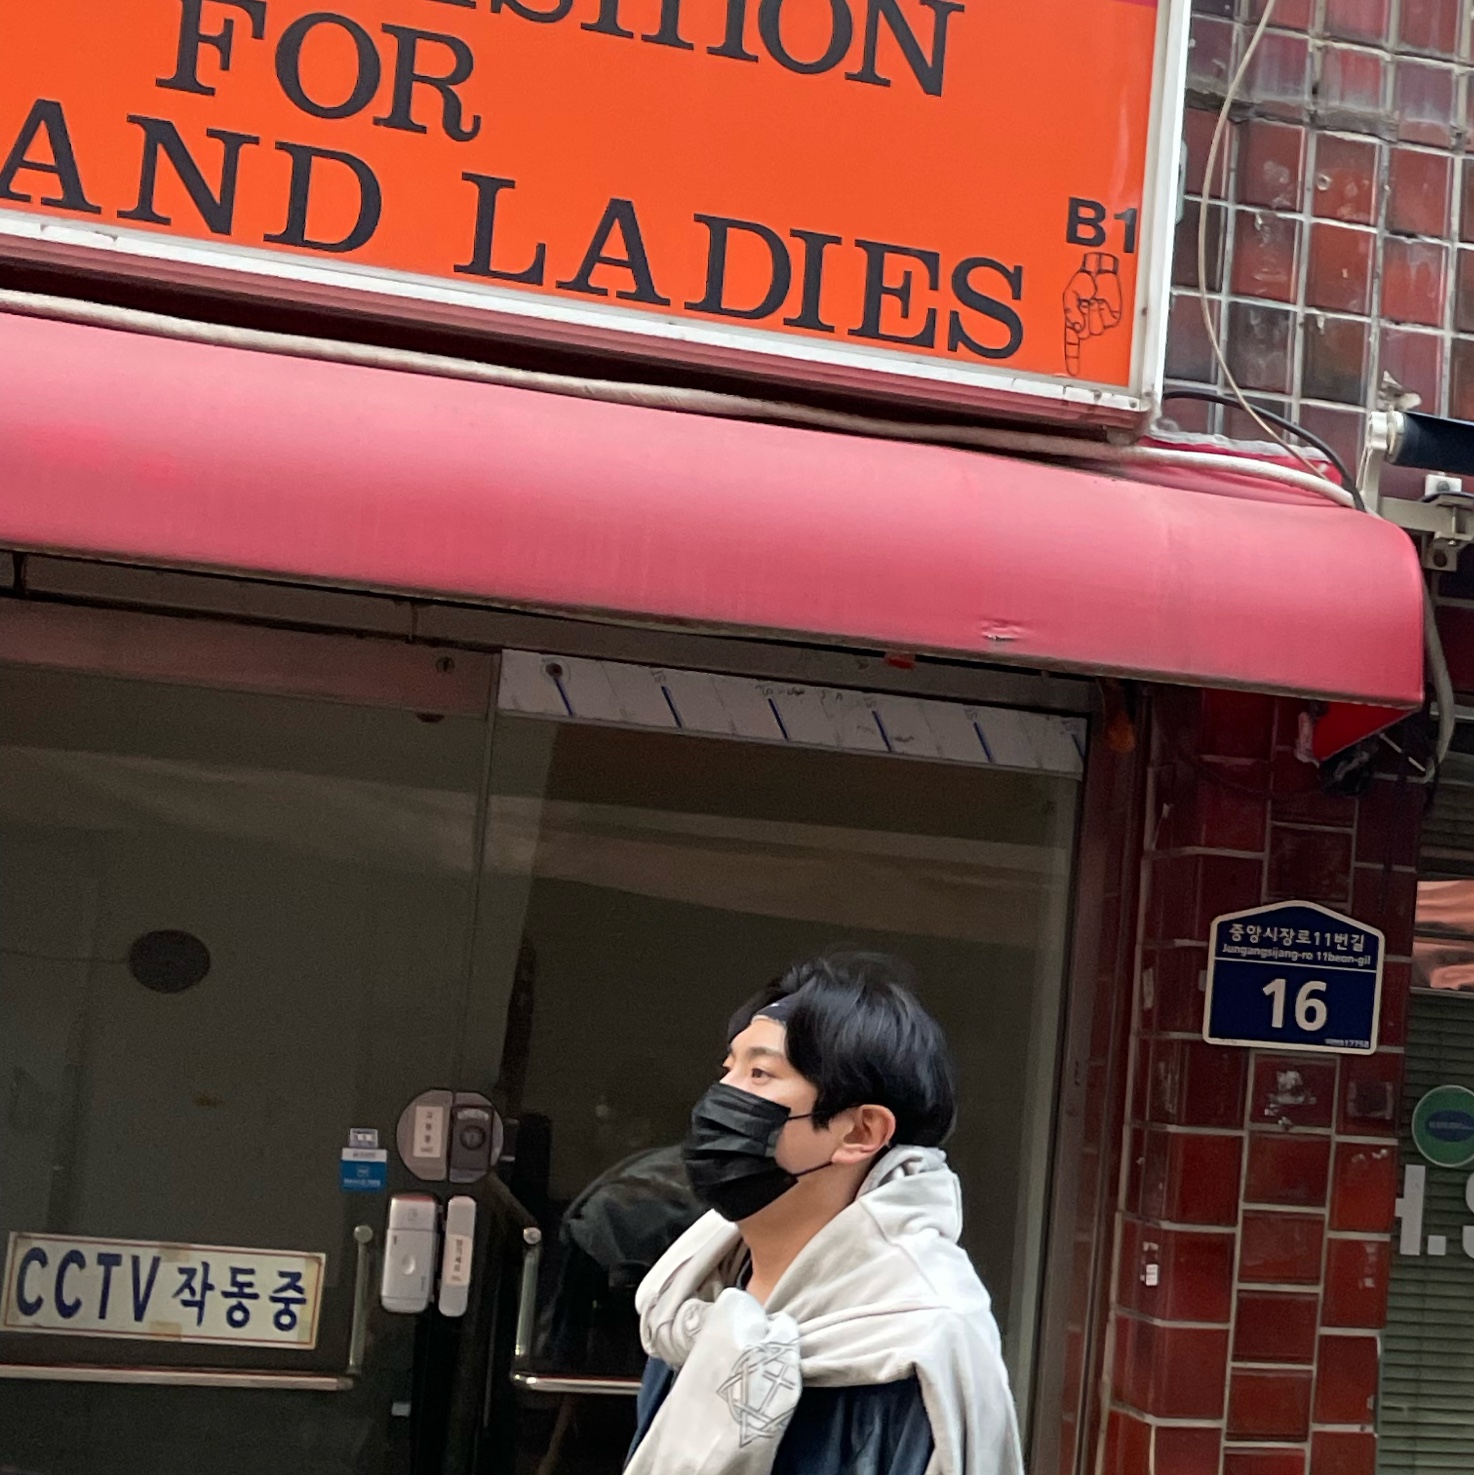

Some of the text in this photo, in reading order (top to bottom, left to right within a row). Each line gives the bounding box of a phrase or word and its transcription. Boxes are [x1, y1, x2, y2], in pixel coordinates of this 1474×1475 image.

[156, 0, 482, 142] FOR
[0, 100, 1023, 359] AND LADIES
[1066, 196, 1137, 253] B1
[1229, 924, 1365, 952] 중앙시장로11번길
[1262, 978, 1328, 1031] 16
[16, 1246, 307, 1331] CCTV 작동중
